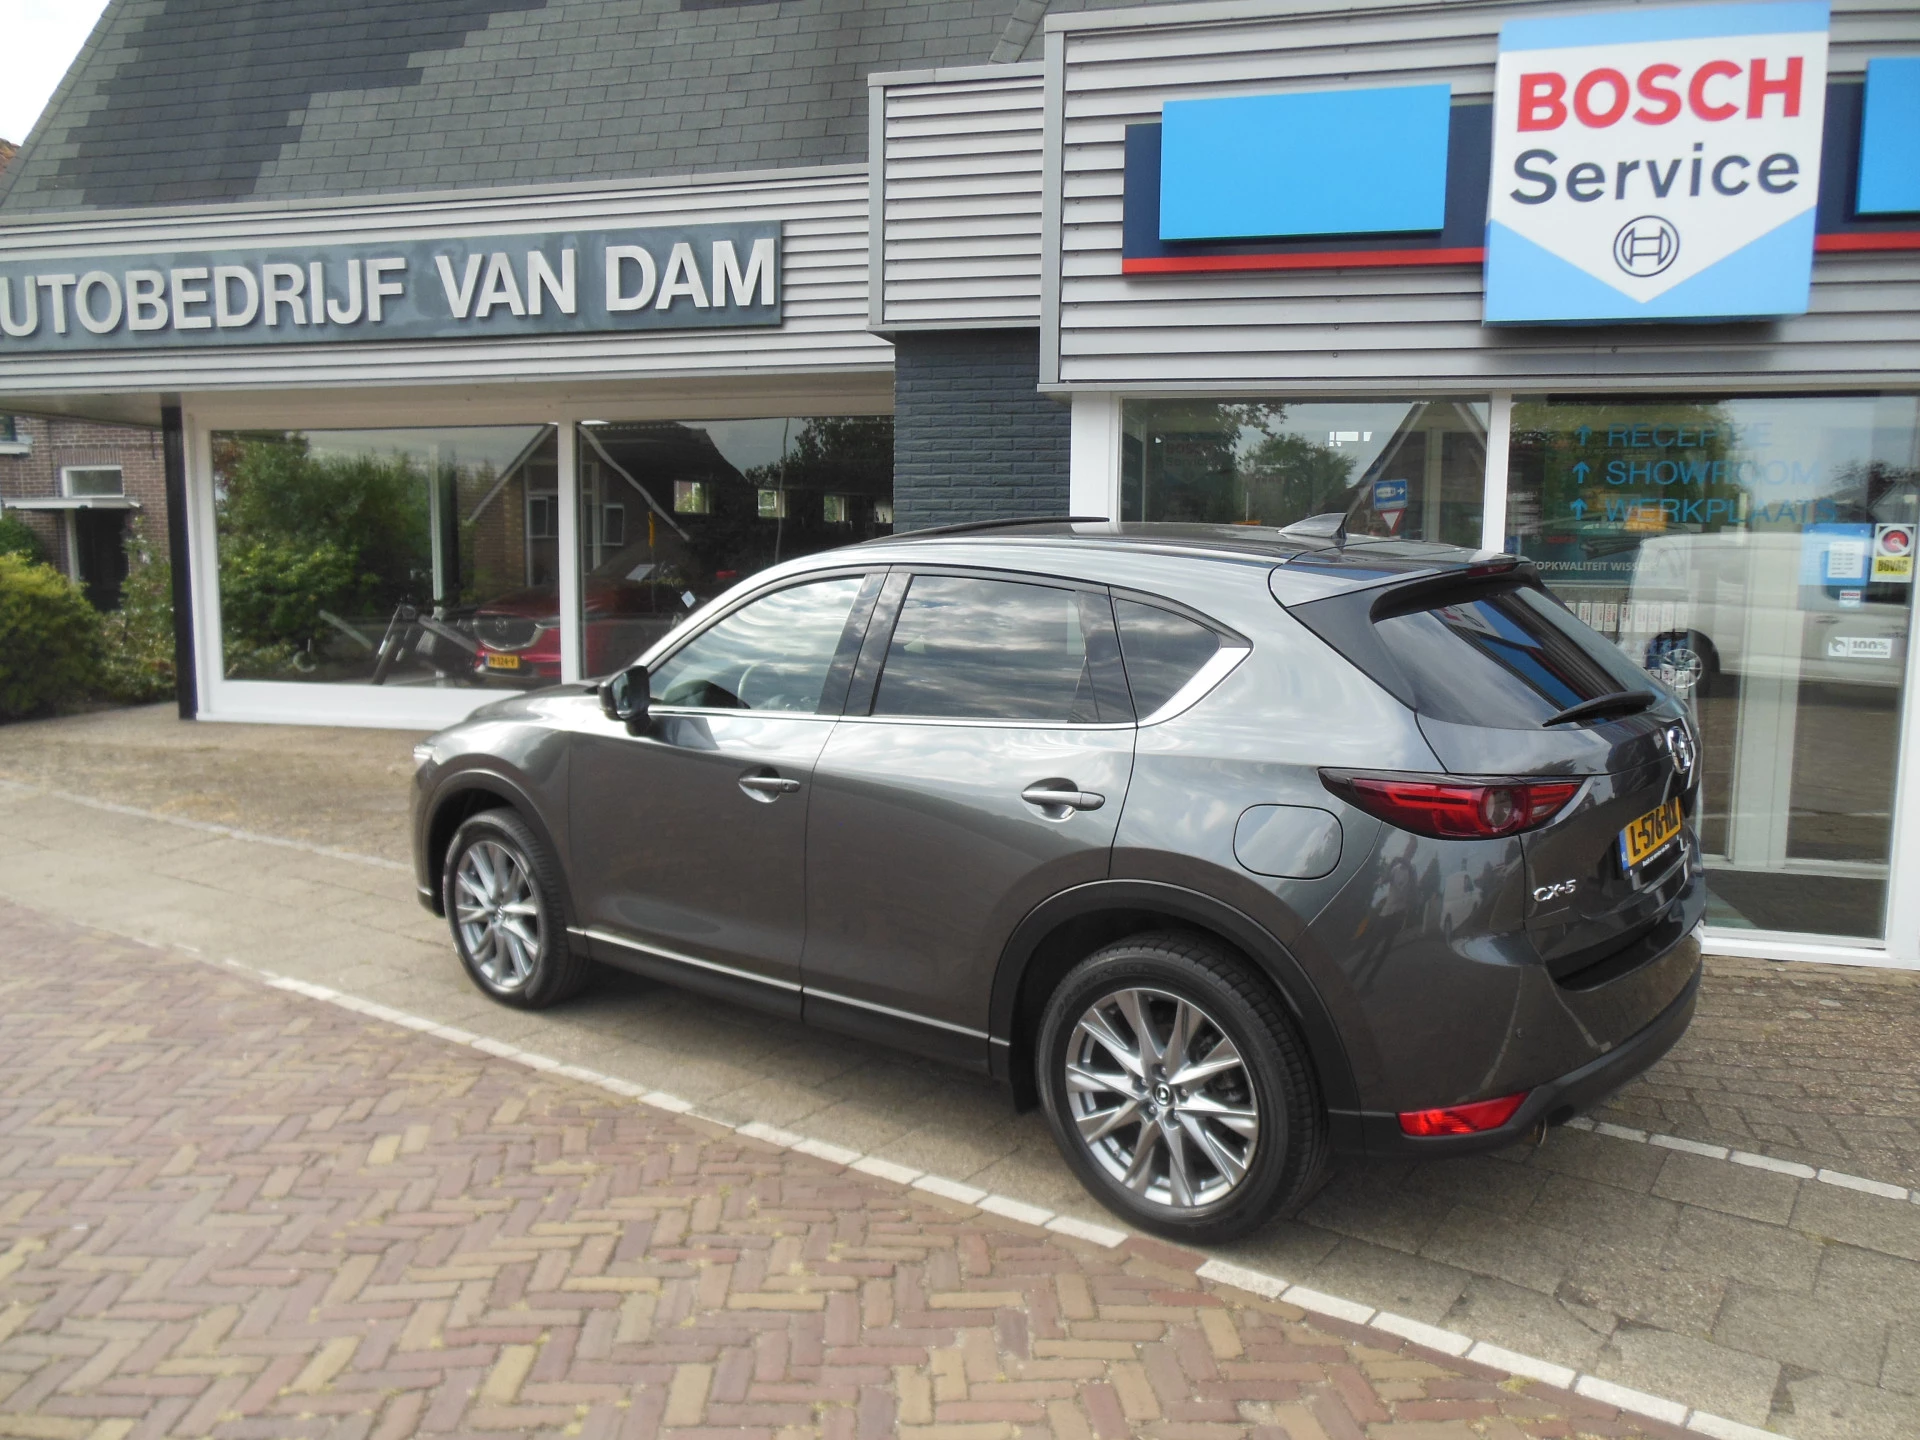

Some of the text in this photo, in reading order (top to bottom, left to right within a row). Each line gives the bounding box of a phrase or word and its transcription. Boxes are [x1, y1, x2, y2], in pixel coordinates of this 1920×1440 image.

[1517, 57, 1803, 132] BOSCH
[1510, 142, 1799, 204] Service
[435, 248, 576, 319] VAN
[604, 238, 776, 311] DAM
[1608, 422, 1773, 447] RECEPTIE
[1606, 460, 1820, 485] SHOWROOM
[1606, 498, 1838, 523] WERKPLAATS
[1852, 640, 1888, 649] 100%
[1533, 879, 1576, 902] CX-5
